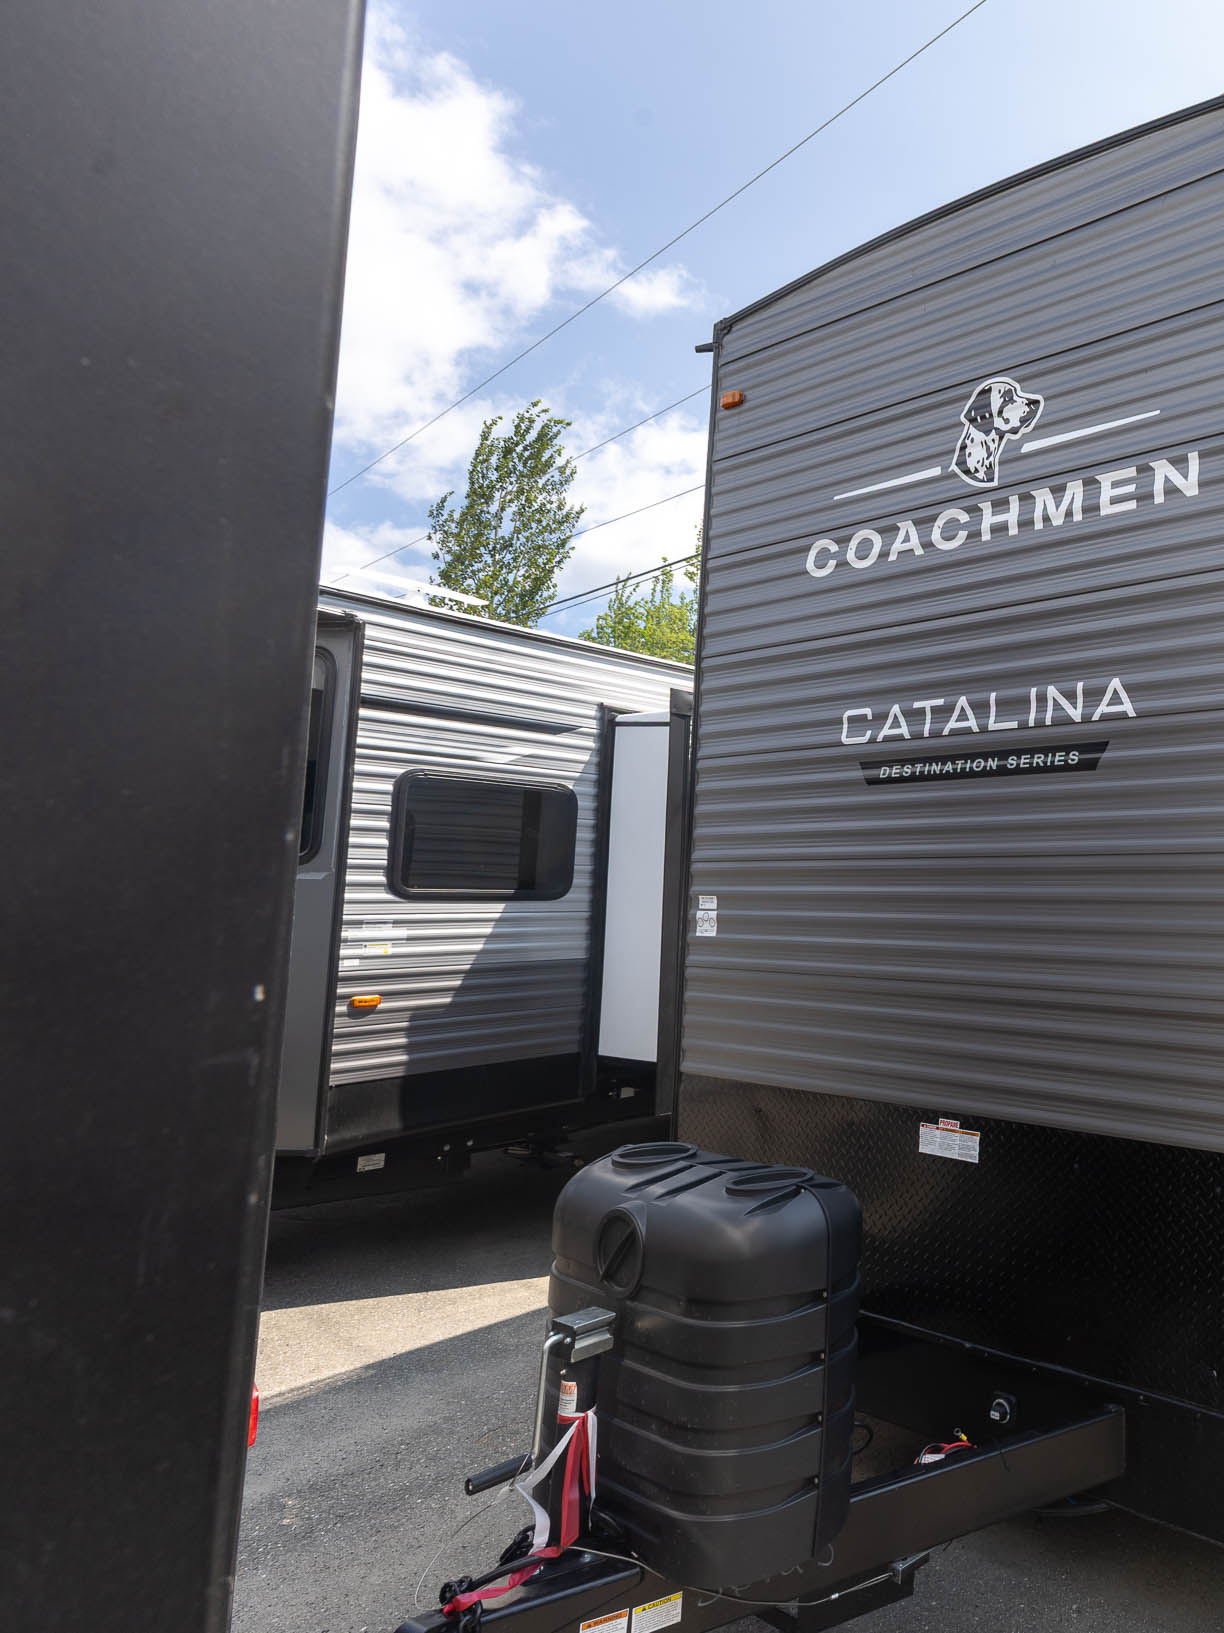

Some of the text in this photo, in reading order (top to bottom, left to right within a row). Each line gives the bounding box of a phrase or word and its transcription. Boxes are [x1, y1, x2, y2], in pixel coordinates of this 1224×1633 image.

[805, 451, 1199, 577] COACHMEN
[840, 677, 1137, 745] CATALINA
[879, 751, 1080, 778] DESTINATION SERIES
